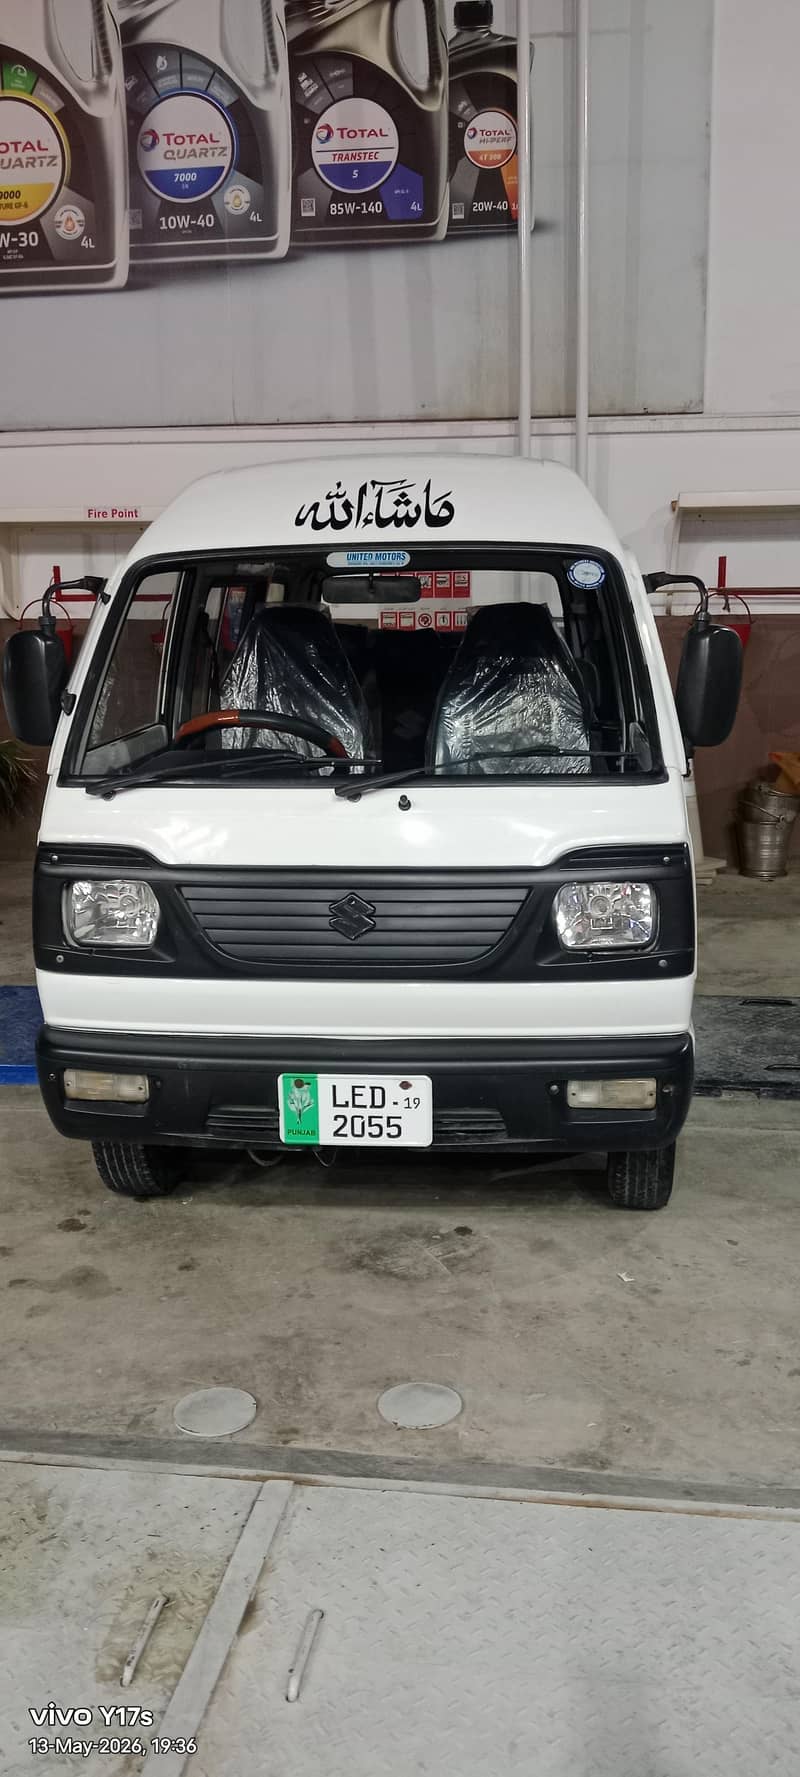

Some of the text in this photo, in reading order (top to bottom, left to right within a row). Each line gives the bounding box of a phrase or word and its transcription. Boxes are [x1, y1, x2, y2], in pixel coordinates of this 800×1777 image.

[337, 128, 388, 139] TOTAL
[480, 129, 511, 137] TOTAL
[163, 133, 220, 146] TOTAL
[163, 146, 228, 161] QUARTZ
[332, 151, 379, 162] TRANSTEC
[173, 172, 197, 183] 7000
[330, 201, 383, 215] 85W-140
[410, 201, 422, 212] 4L
[472, 201, 508, 212] 20W-40
[159, 214, 215, 230] 10W-40
[250, 211, 263, 223] 4L
[81, 235, 95, 249] 4L
[87, 508, 138, 518] Fire Point
[346, 552, 406, 561] UNITED MOTORS
[332, 1084, 386, 1109] LED
[333, 1114, 402, 1139] 2055
[287, 1128, 316, 1137] PUNJAB
